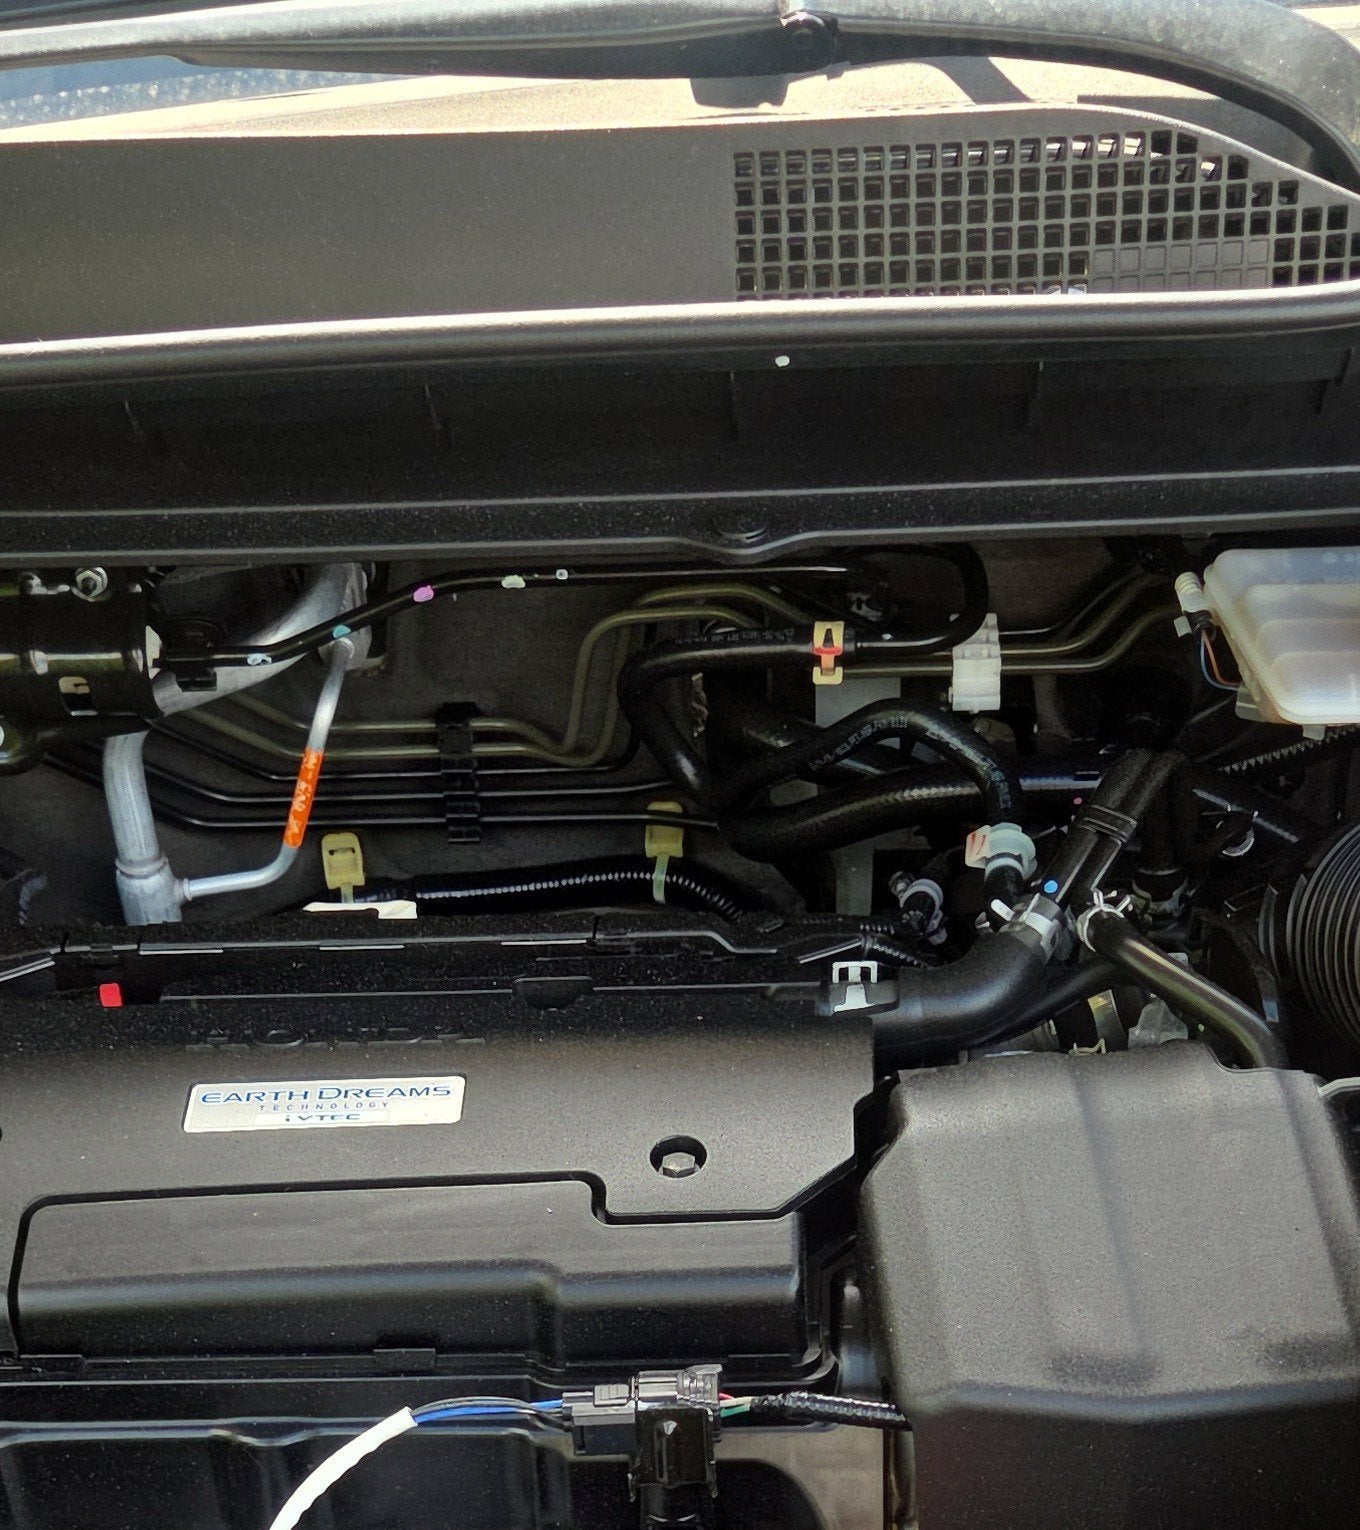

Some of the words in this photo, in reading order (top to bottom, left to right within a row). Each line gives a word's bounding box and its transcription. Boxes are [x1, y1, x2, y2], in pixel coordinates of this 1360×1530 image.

[201, 1090, 309, 1104] EARTH
[317, 1086, 452, 1101] DREAMS
[259, 1101, 390, 1112] TECHNOLOGY
